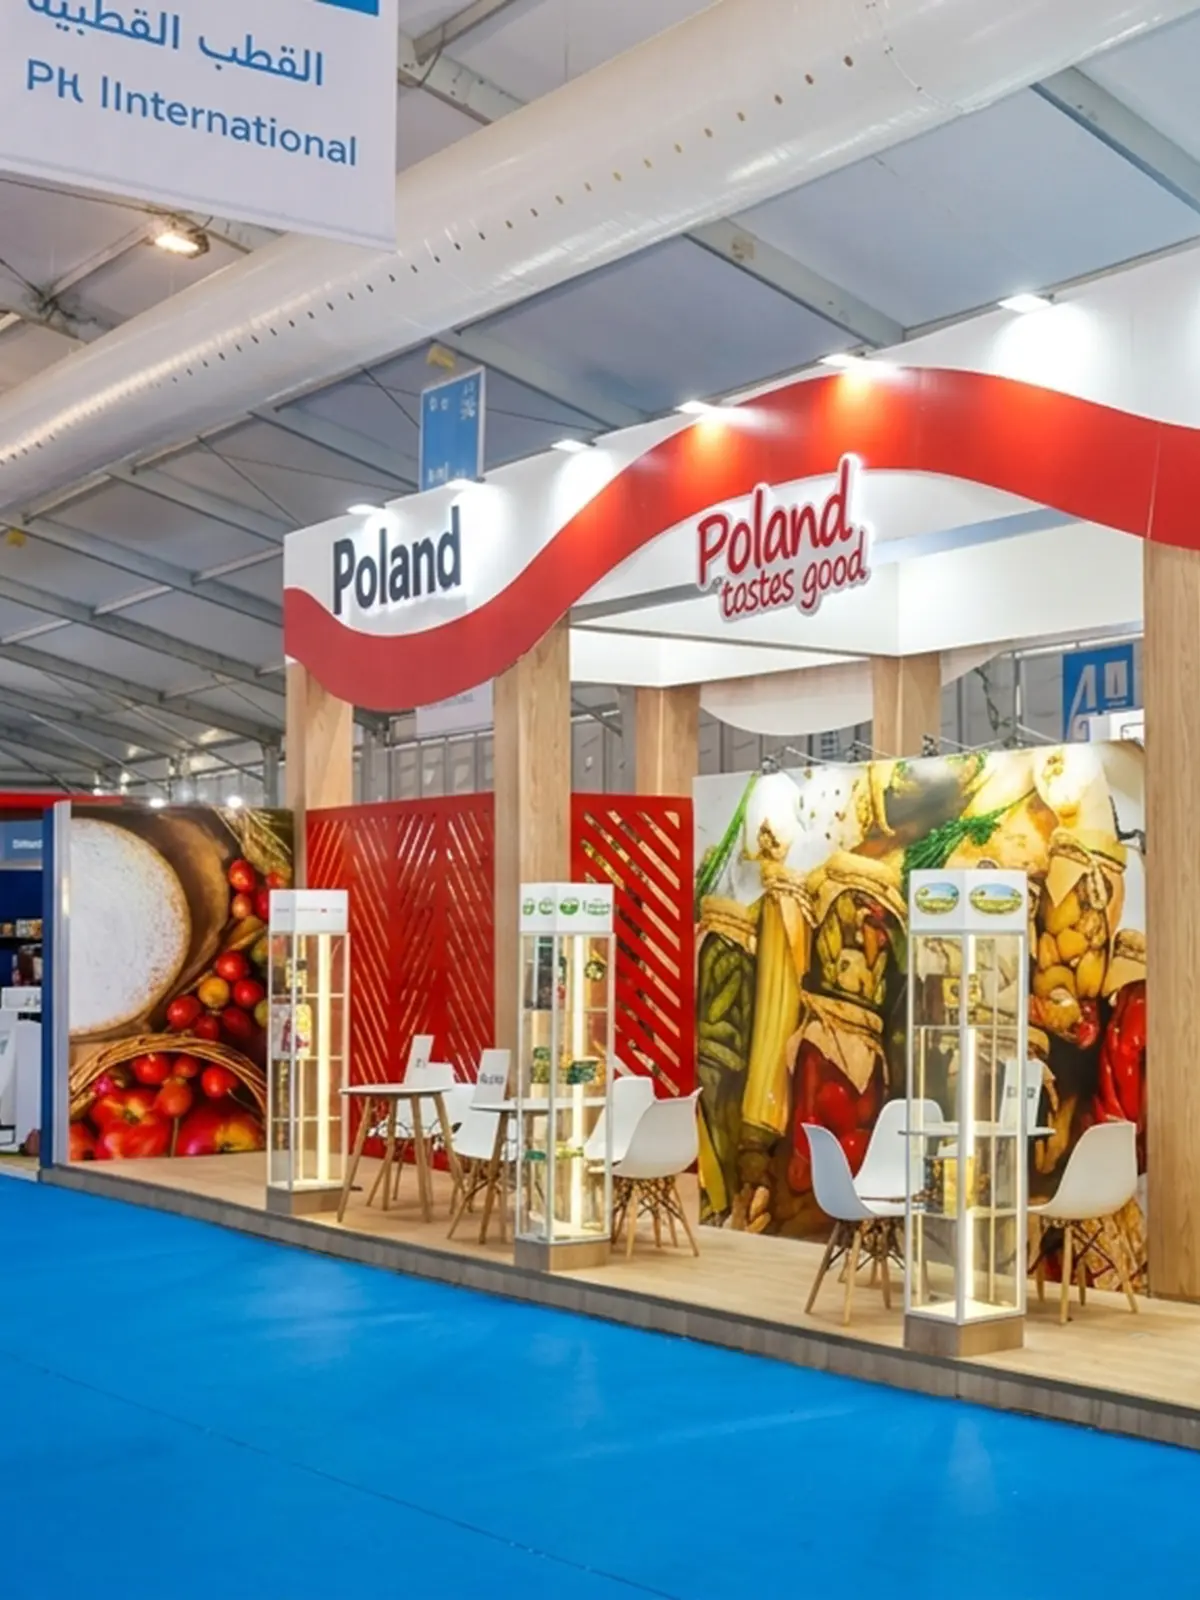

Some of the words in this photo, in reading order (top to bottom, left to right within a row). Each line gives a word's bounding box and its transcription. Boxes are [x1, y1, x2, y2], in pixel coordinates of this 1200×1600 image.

[198, 33, 323, 86] القطب
[332, 504, 462, 616] Poland
[696, 457, 854, 586] Poland
[721, 567, 795, 618] tastes
